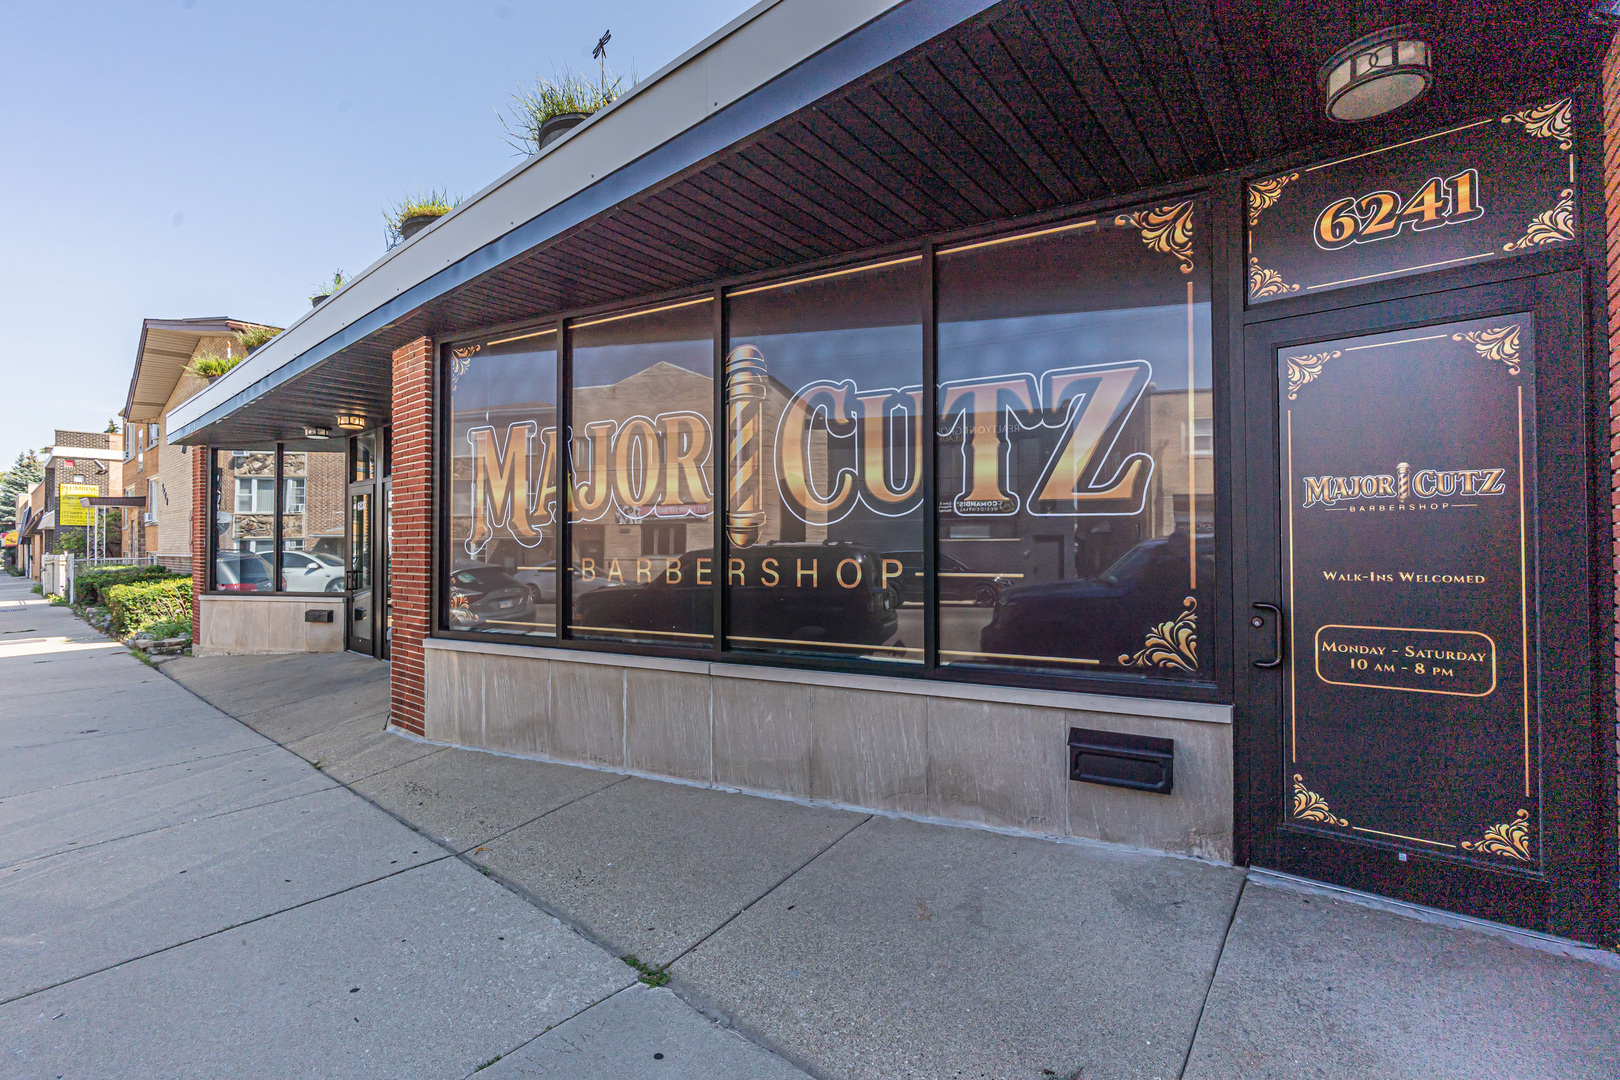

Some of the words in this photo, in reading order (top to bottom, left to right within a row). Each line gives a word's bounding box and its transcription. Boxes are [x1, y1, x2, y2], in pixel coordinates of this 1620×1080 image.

[1315, 169, 1484, 250] 6241
[467, 411, 715, 552] MAJOR
[775, 360, 1154, 524] CUTZ
[1303, 474, 1396, 508] MAJOR
[1412, 468, 1505, 496] CUTZ
[1349, 502, 1450, 513] BARBERSHOP
[581, 557, 903, 590] BARBERSHOP
[1322, 570, 1394, 583] WALK-INS
[1399, 571, 1486, 585] WELCOMED
[1322, 641, 1386, 655] MONDAY
[1404, 646, 1487, 662] SATURDAY
[1350, 659, 1368, 671] 10
[1414, 662, 1426, 675] 8
